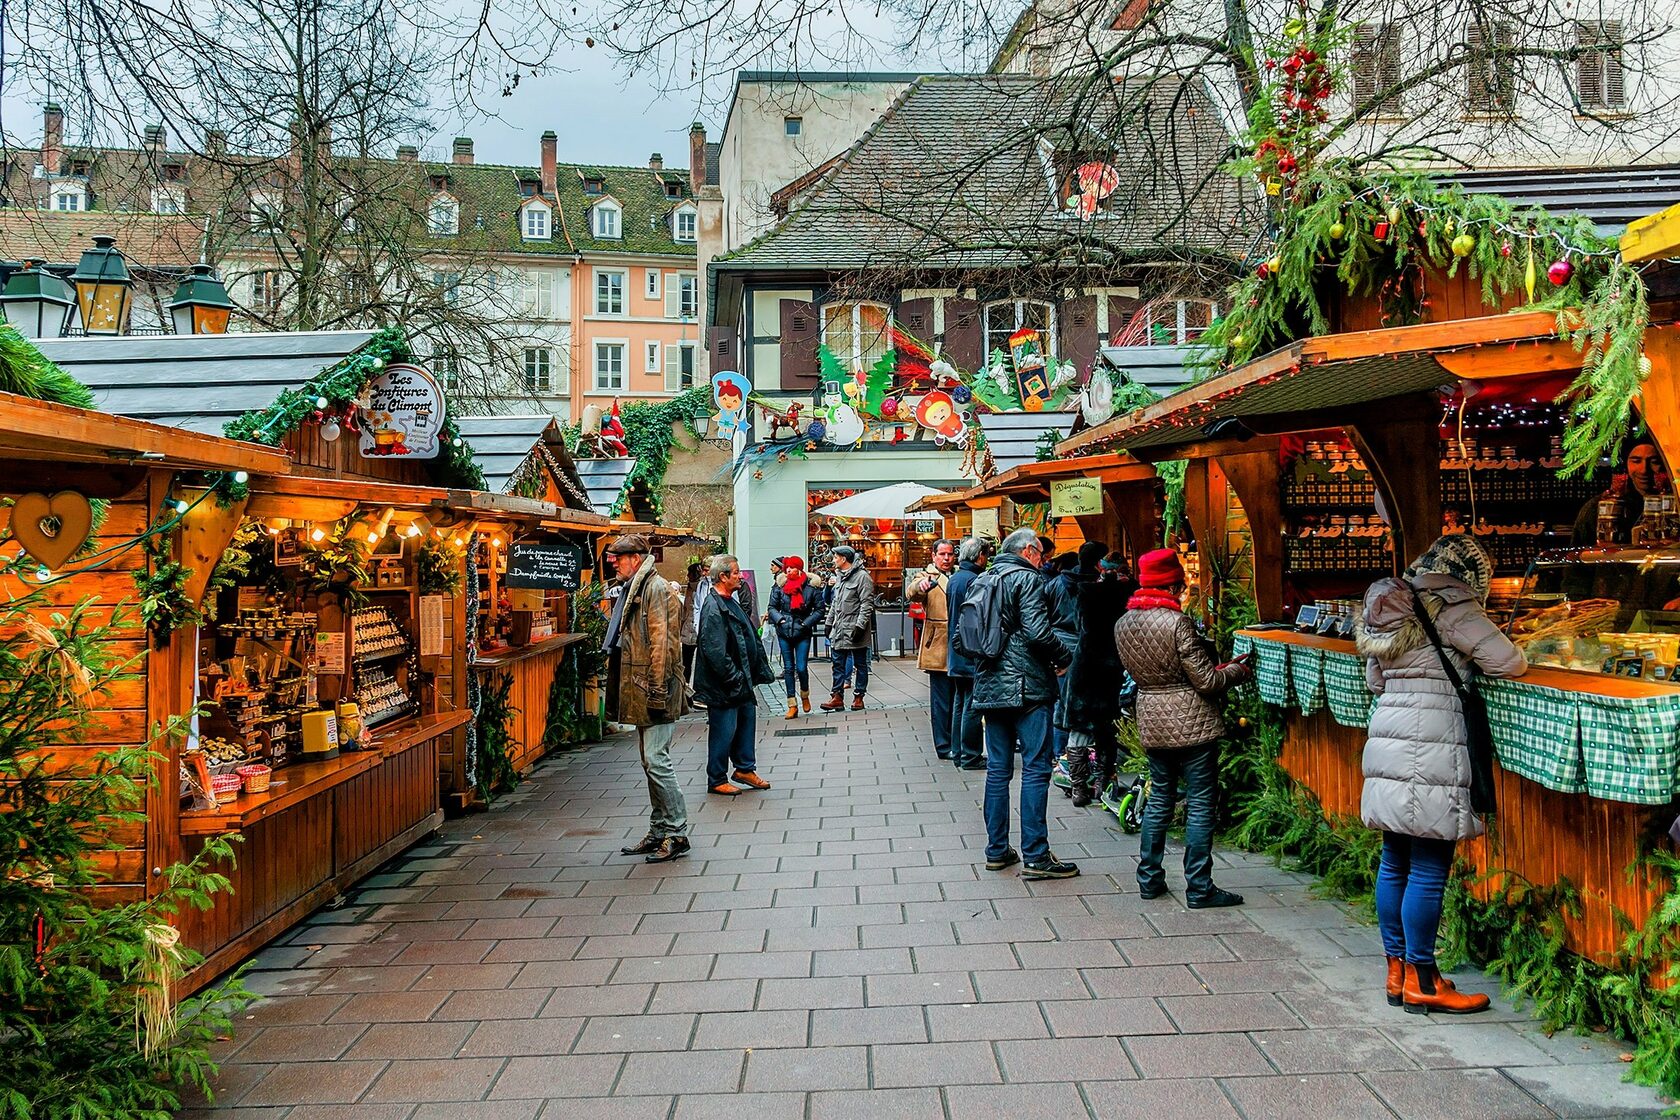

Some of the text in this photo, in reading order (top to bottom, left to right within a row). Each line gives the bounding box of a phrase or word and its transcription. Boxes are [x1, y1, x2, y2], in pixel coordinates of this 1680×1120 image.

[388, 373, 412, 384] Les
[371, 399, 433, 413] du Climont
[1055, 481, 1097, 493] Dégustation
